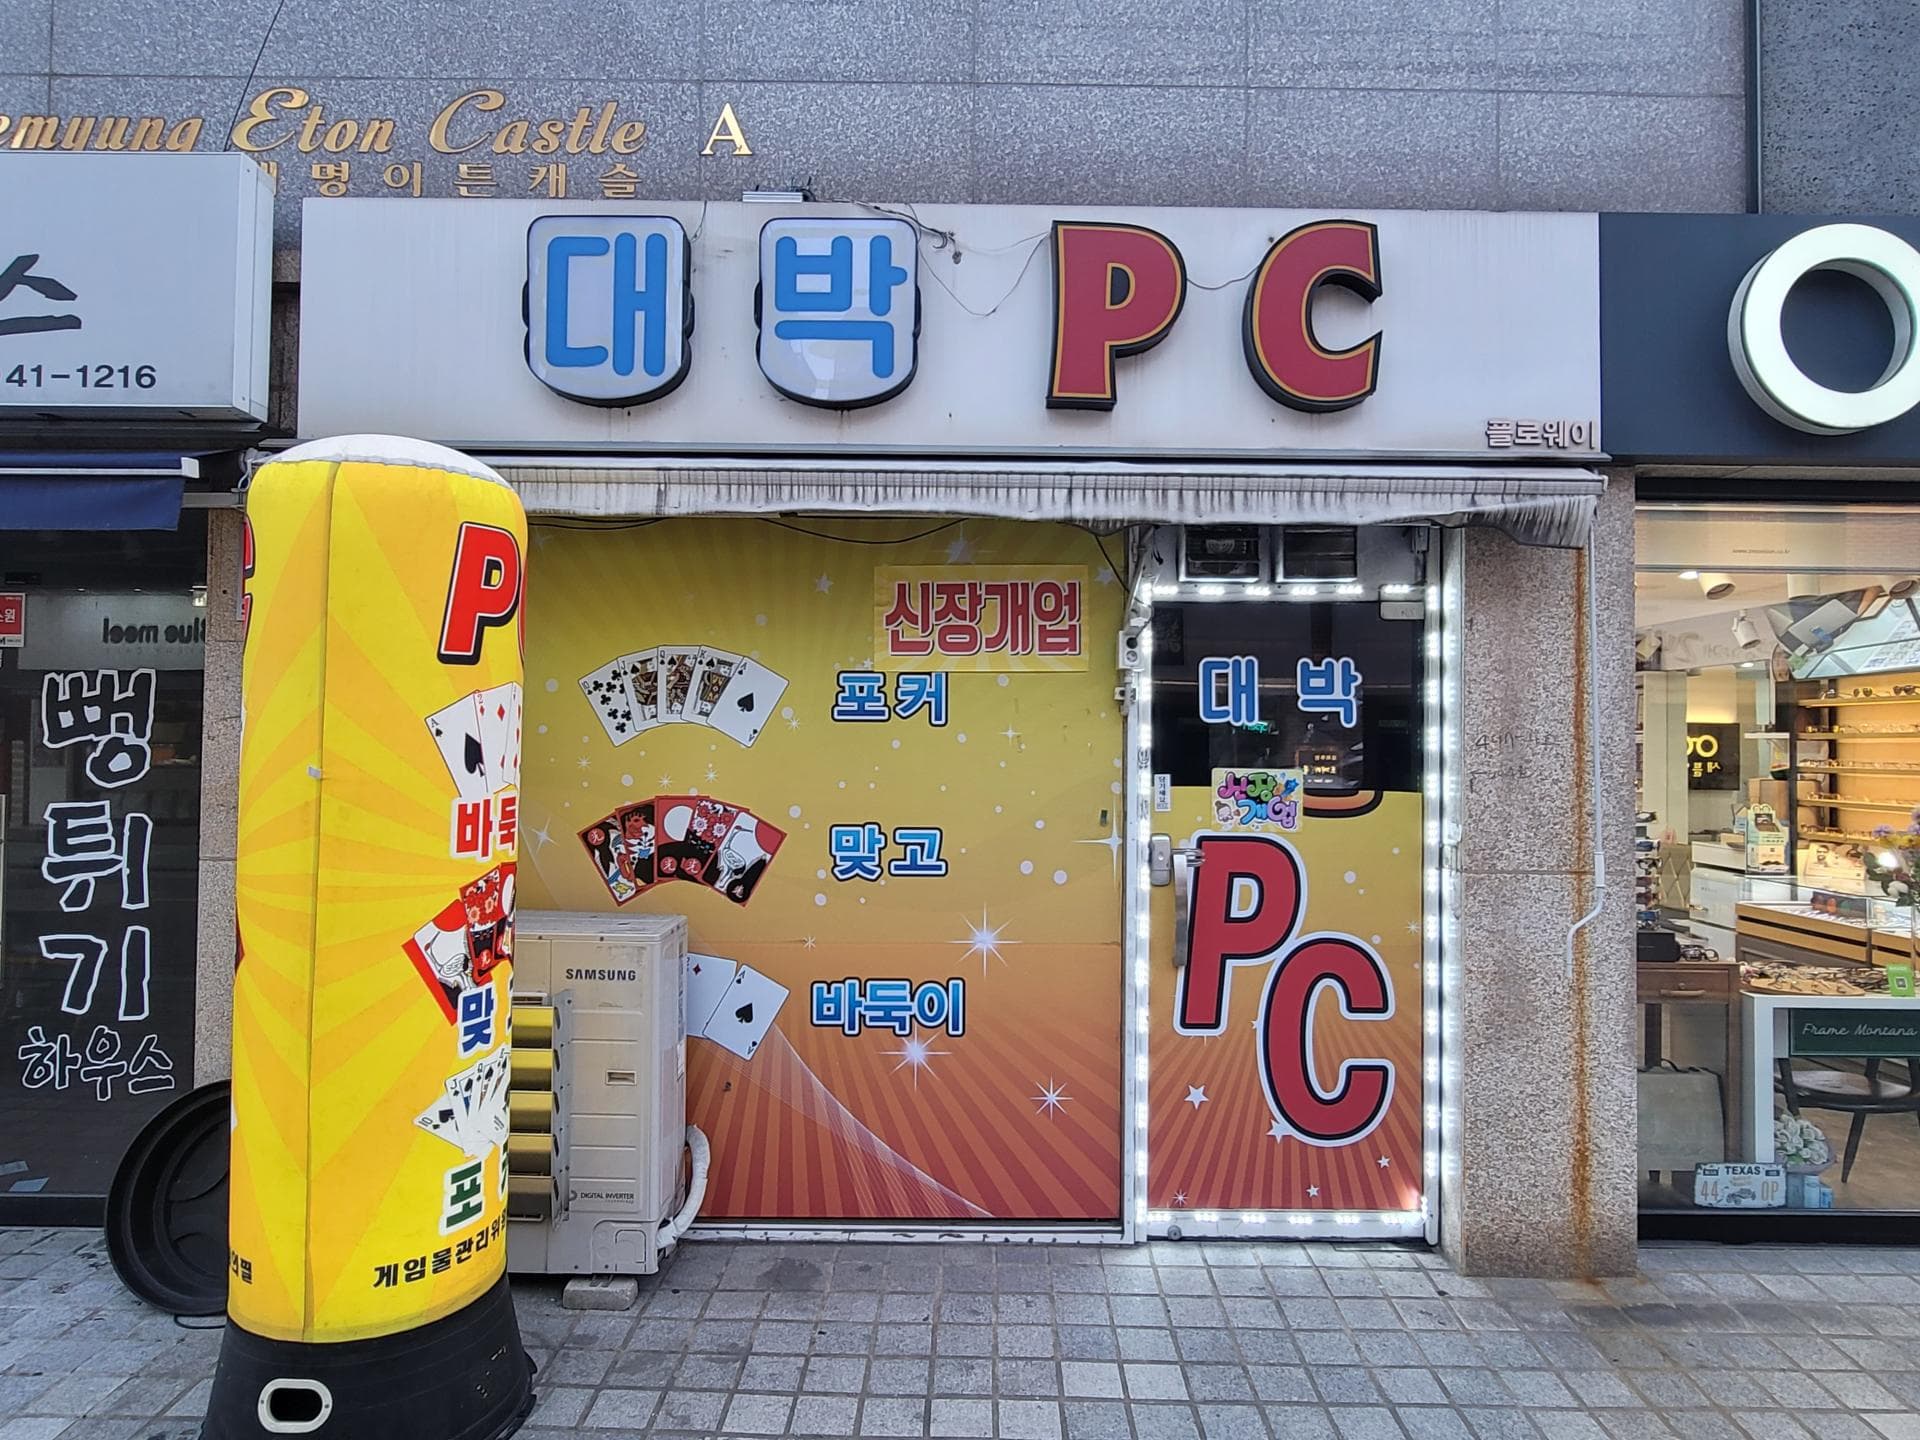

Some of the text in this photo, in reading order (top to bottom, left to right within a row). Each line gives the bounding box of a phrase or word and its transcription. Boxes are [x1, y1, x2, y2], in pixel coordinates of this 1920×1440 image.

[231, 87, 396, 154] Eton
[429, 89, 648, 154] Castle
[700, 101, 754, 155] A
[538, 219, 1384, 413] 대박 PC
[1485, 418, 1597, 450] 플로웨이
[883, 580, 1082, 657] 신장개업
[831, 671, 949, 728] 포커
[1199, 655, 1363, 729] 대박
[828, 821, 949, 882] 맞고
[565, 967, 637, 981] SAMSUNG
[1173, 832, 1396, 1147] PC
[809, 976, 966, 1037] 바둑이
[1802, 1023, 1850, 1036] Frame
[18, 1025, 176, 1101] 하우스
[580, 1191, 635, 1201] DIGITAL INVERTER
[1724, 1165, 1761, 1176] TEXAS
